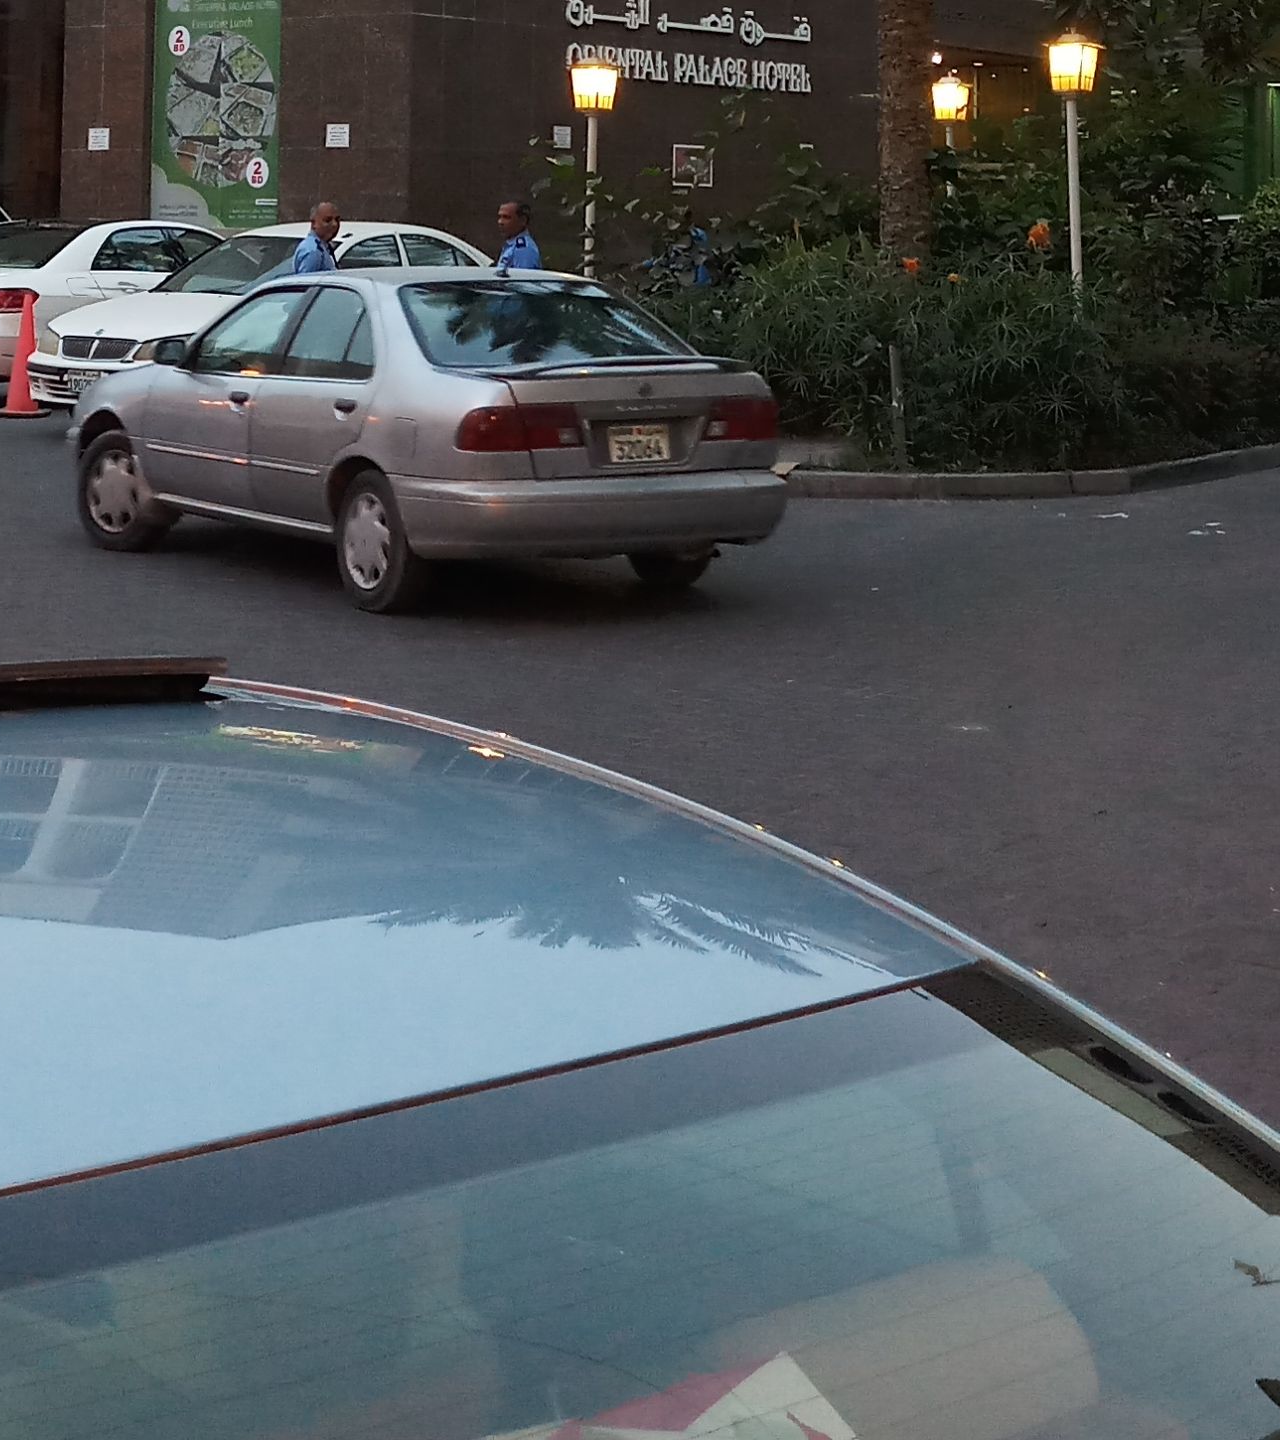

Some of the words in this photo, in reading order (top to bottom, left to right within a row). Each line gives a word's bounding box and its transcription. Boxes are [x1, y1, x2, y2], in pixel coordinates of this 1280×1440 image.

[175, 30, 183, 43] 2
[173, 44, 185, 52] BD
[674, 52, 747, 88] PALACE
[750, 59, 812, 94] HOTEL
[253, 161, 262, 175] 2
[251, 175, 263, 184] BD
